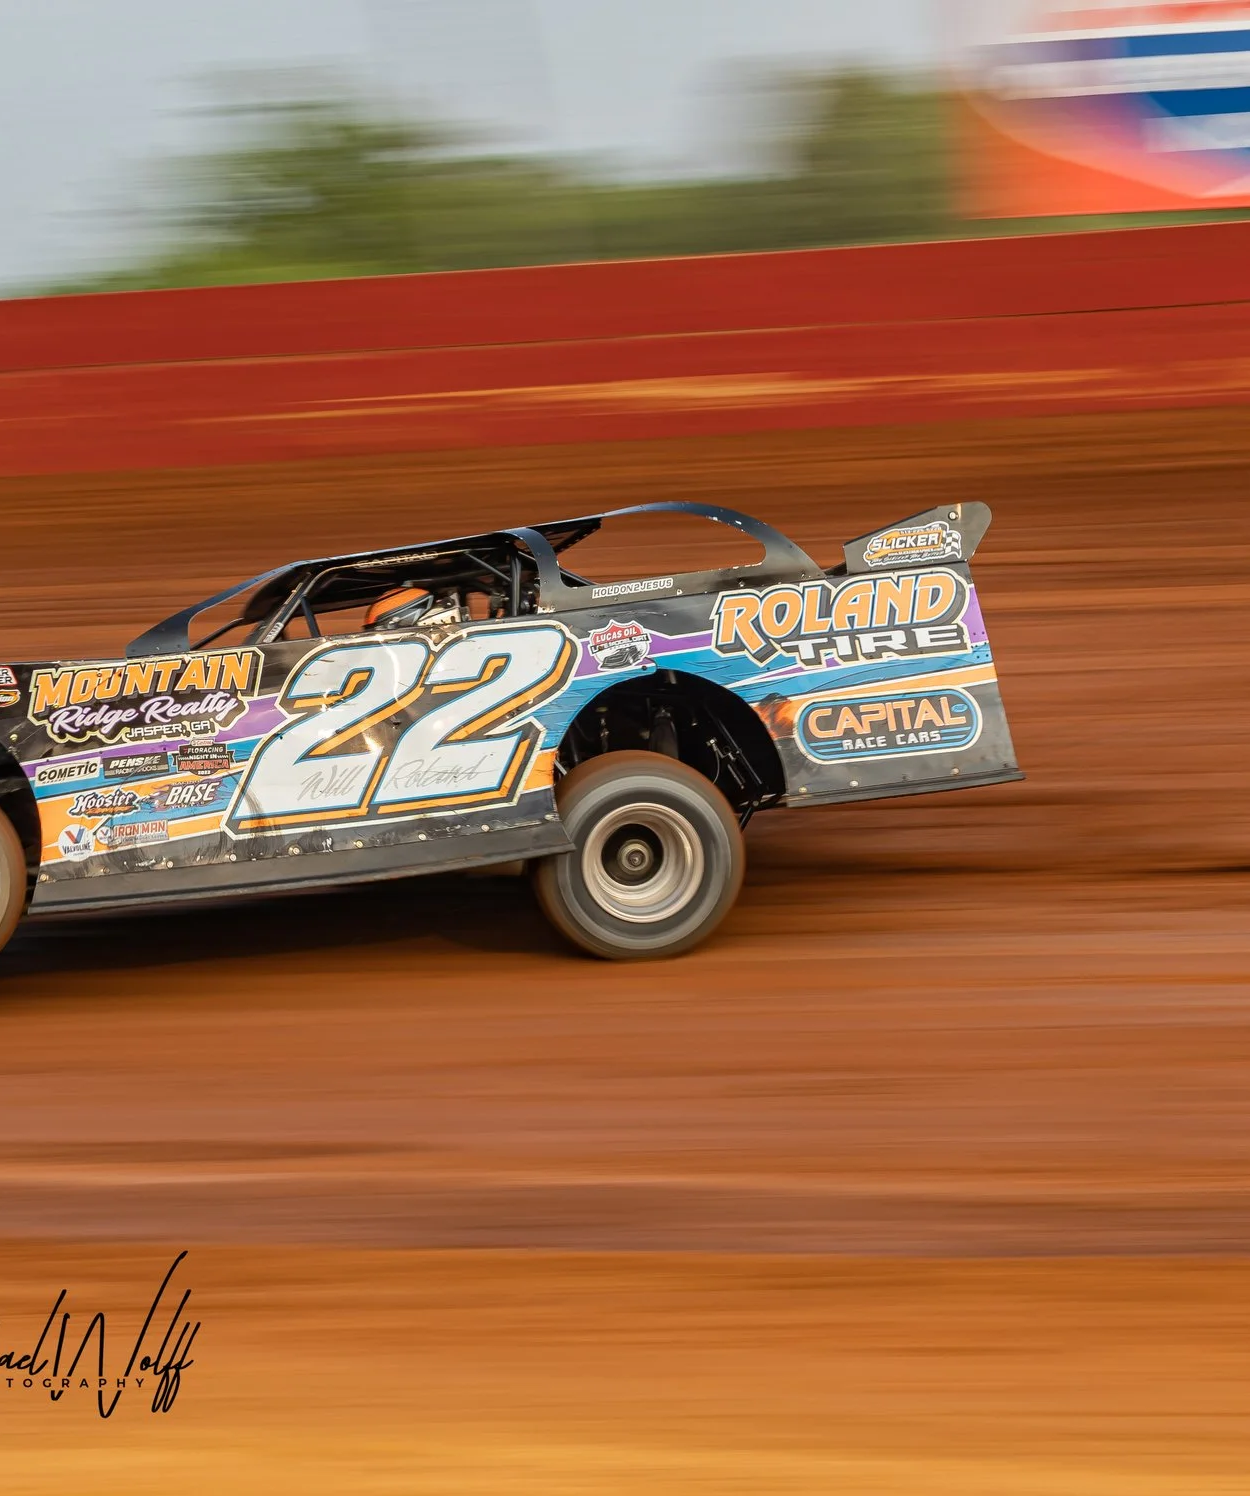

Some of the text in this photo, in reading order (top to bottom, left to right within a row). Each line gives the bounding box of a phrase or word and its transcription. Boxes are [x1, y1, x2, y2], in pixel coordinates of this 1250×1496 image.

[871, 533, 939, 551] SLICKER
[593, 580, 672, 597] HOLDON2JESUS
[717, 572, 957, 654] ROLAND
[596, 627, 638, 643] LUCAS OIL
[781, 625, 961, 660] TIRE
[34, 652, 253, 714] MOUNTAIN
[50, 691, 238, 734] Ridge Realty
[808, 696, 967, 739] CAPITAL
[126, 721, 211, 738] JASPER, GA
[230, 626, 574, 830] 22
[187, 746, 224, 754] FLORACING
[842, 730, 942, 750] RACE CARS
[38, 761, 97, 782] COMETIC
[109, 755, 161, 769] PENSKE
[180, 759, 229, 770] AMERICA
[71, 789, 134, 813] Hoosier
[166, 782, 220, 805] BASE
[114, 821, 165, 838] IRON MAN
[62, 842, 92, 855] VALVOLINE
